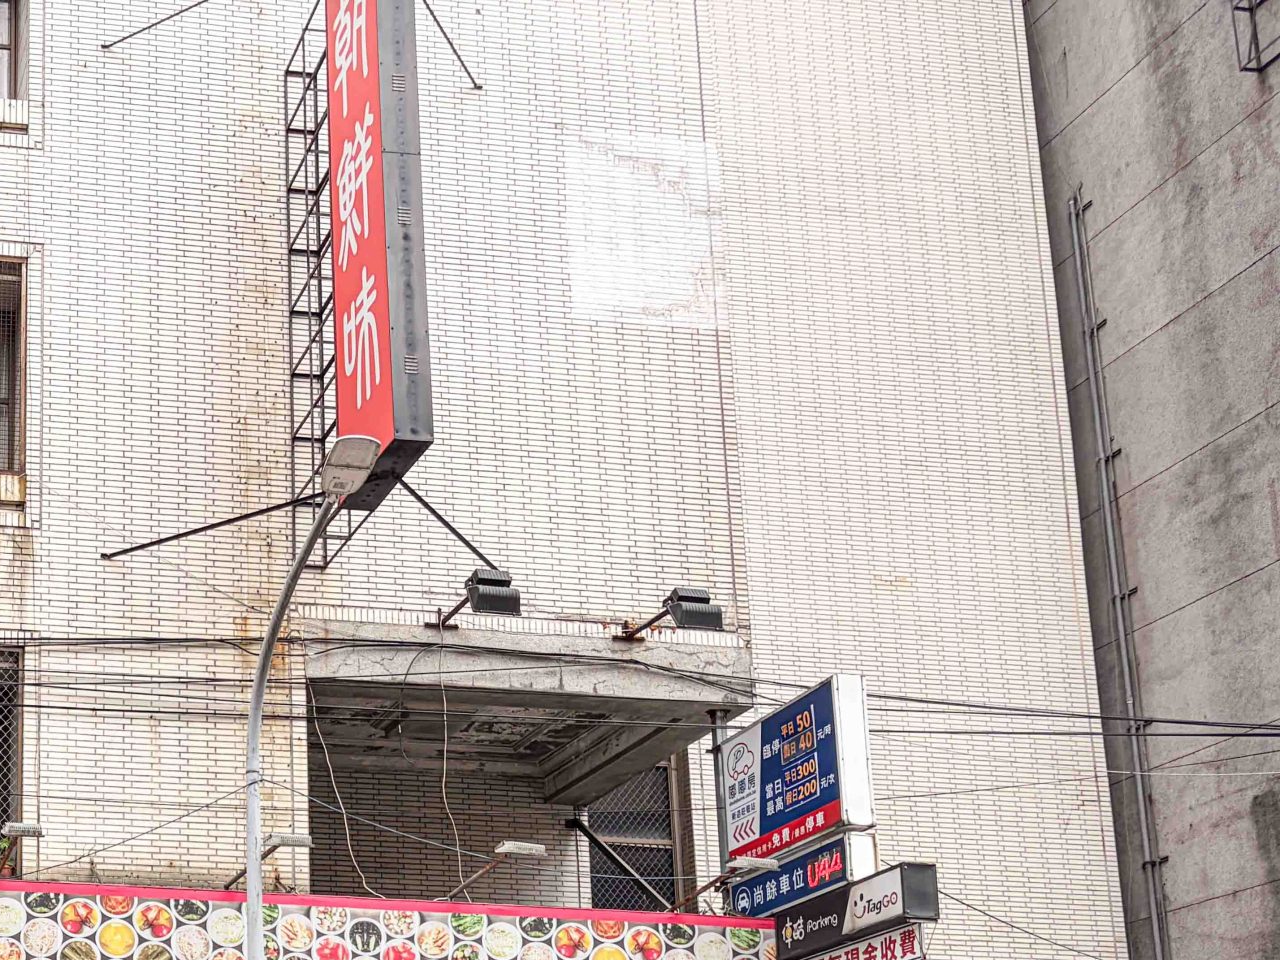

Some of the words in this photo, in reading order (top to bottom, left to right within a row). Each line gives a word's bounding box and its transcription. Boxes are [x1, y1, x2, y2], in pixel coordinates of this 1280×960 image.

[332, 0, 381, 410] 朝鮮味
[781, 721, 794, 738] 平日
[796, 711, 810, 732] 50
[762, 739, 780, 760] 臨停
[799, 732, 812, 751] 40
[765, 778, 782, 799] 當日
[766, 796, 784, 816] 最高
[753, 867, 805, 907] 尚餘車位
